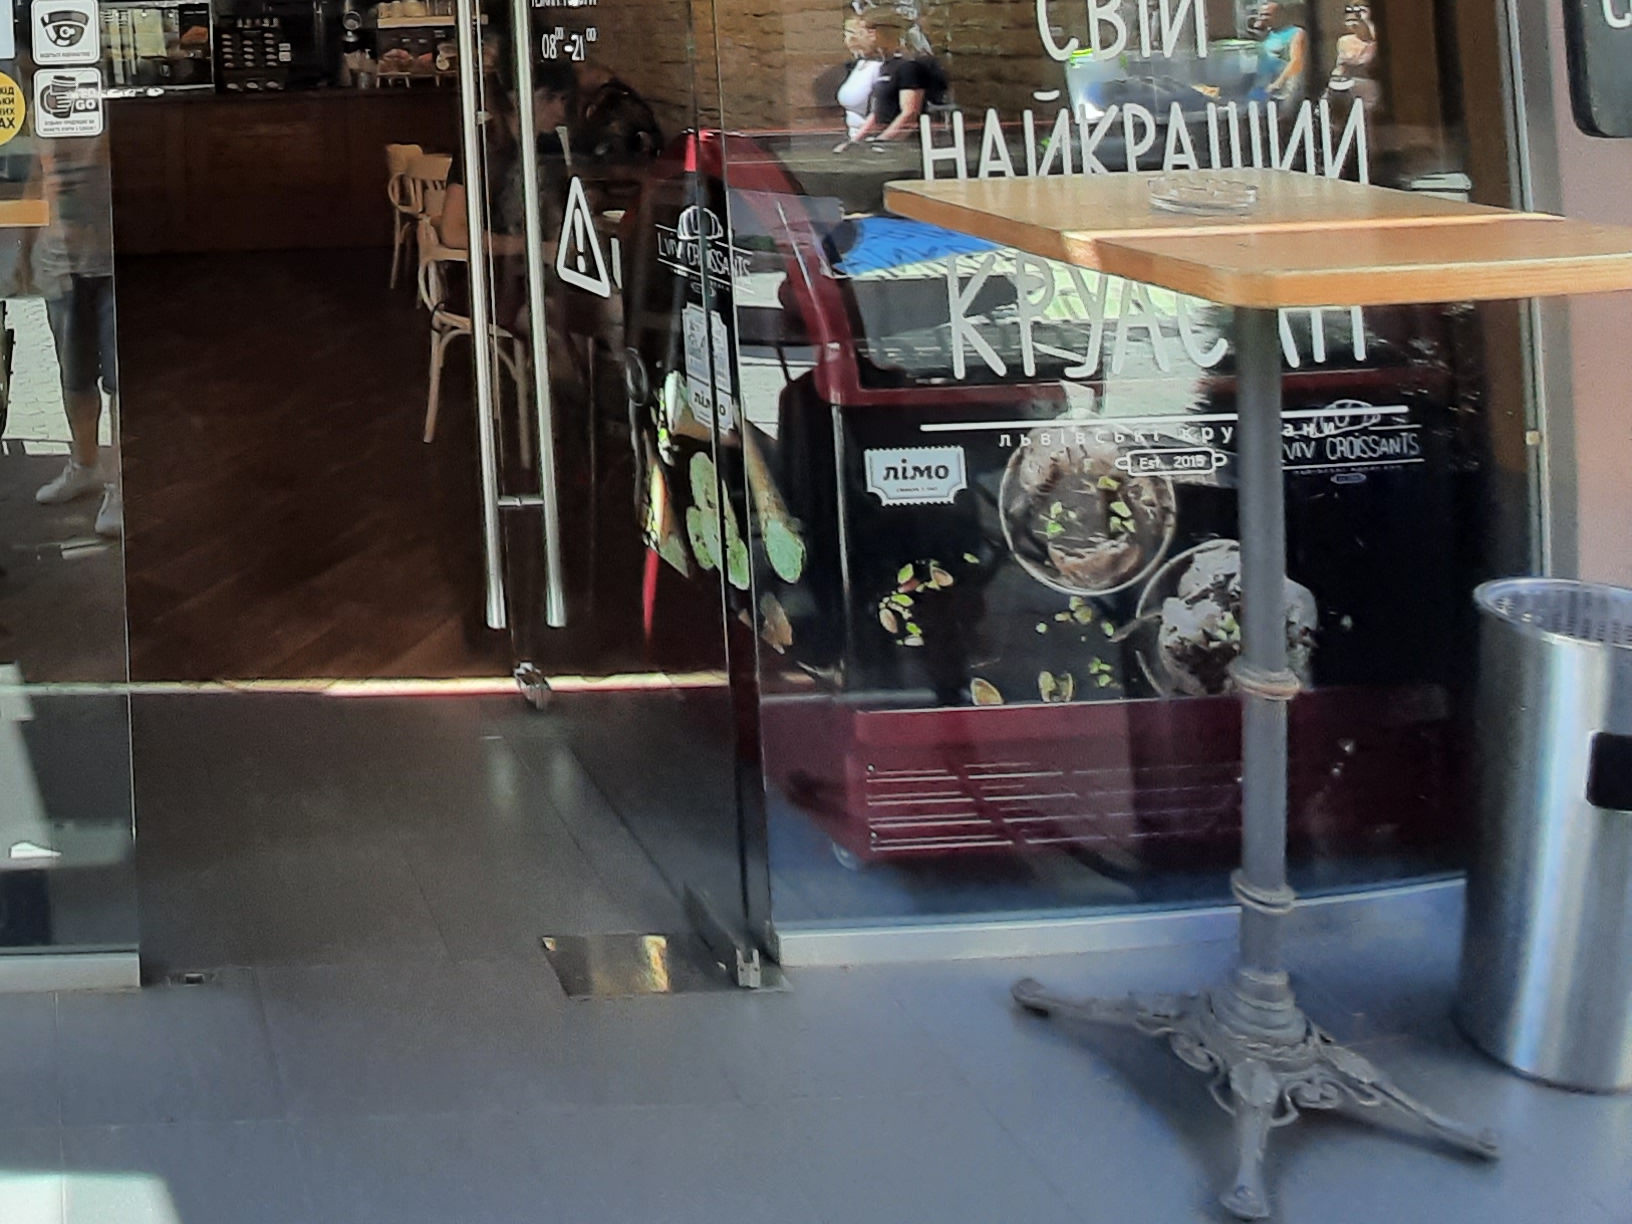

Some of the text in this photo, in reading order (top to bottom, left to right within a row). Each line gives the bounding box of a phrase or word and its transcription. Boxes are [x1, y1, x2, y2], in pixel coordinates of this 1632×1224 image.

[75, 99, 96, 111] GO
[998, 428, 1160, 448] львівські
[883, 458, 950, 481] лімо
[1172, 455, 1209, 469] 2015
